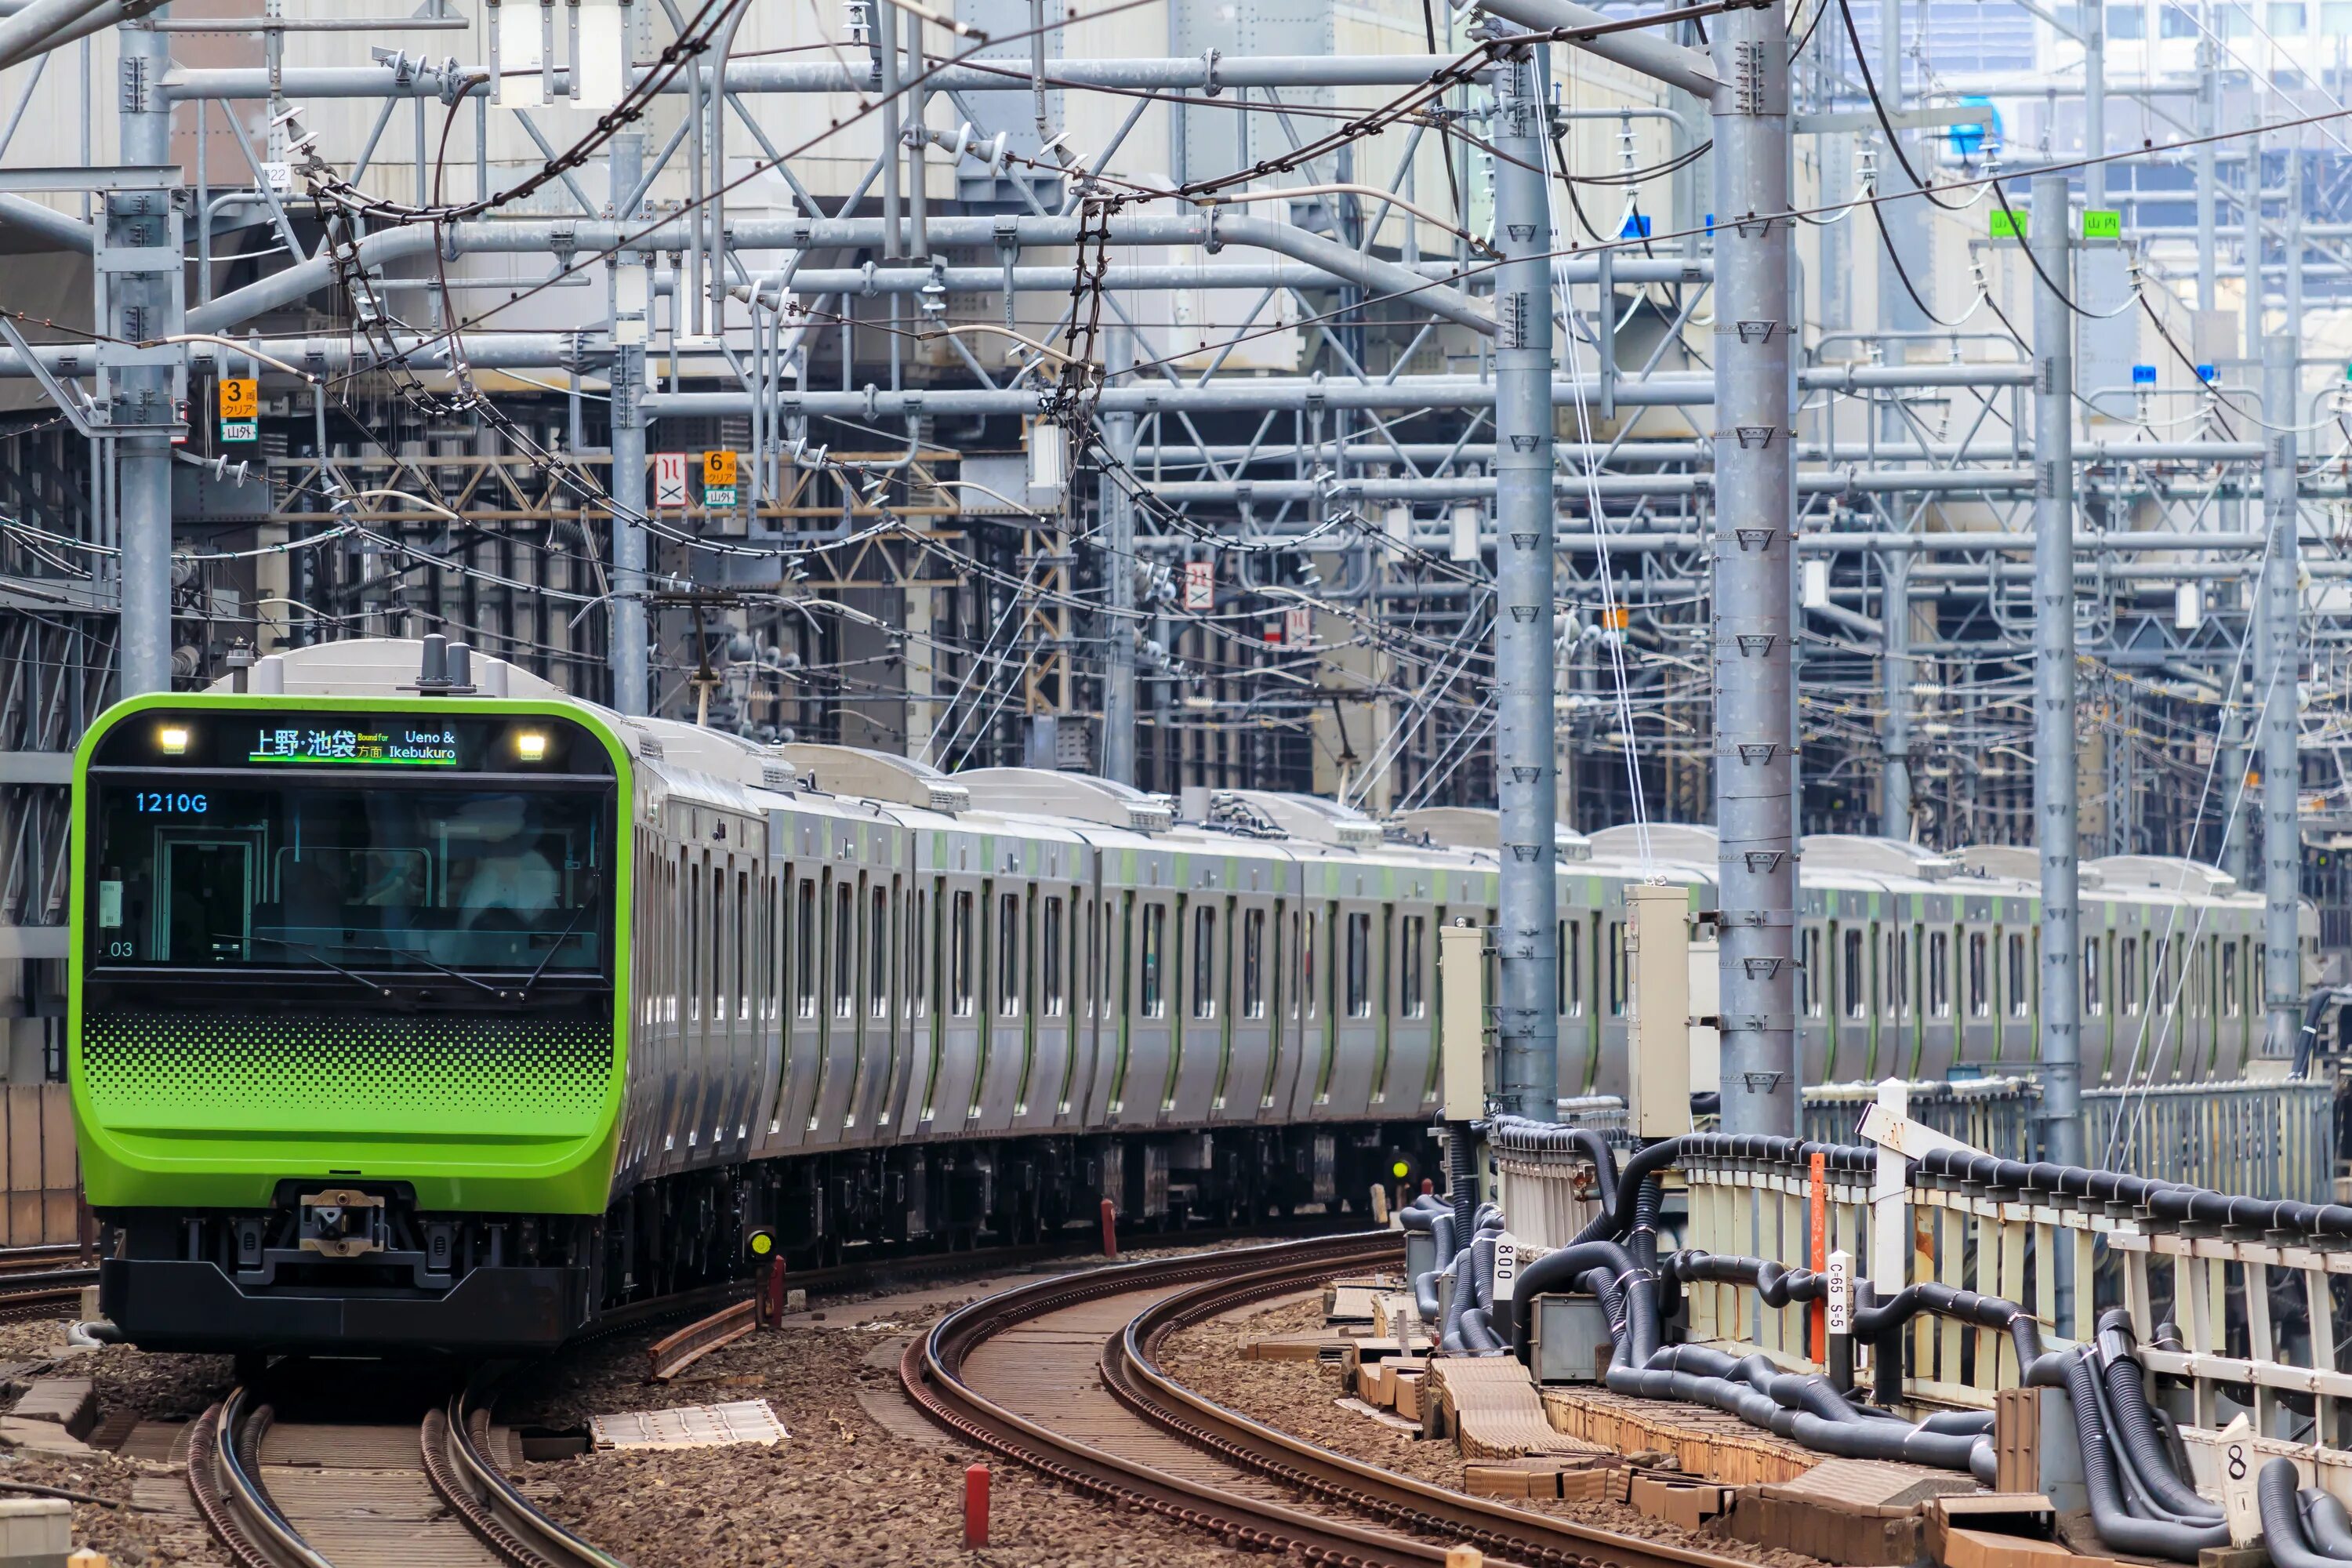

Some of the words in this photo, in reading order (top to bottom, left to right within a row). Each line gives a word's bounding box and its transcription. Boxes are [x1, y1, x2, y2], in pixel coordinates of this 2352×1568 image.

[2088, 216, 2116, 229] 山内
[225, 405, 252, 416] クリア
[227, 426, 251, 439] 山外
[709, 473, 732, 483] クリア
[710, 492, 731, 503] 山外
[358, 733, 377, 742] Bound
[378, 733, 389, 742] for
[405, 731, 440, 743] Ueno
[443, 731, 455, 743] &
[357, 746, 383, 758] 方面
[390, 746, 456, 758] Ikebukuro
[136, 793, 207, 812] 1210G
[111, 942, 132, 956] 03
[1497, 1245, 1513, 1279] 800
[1830, 1264, 1843, 1293] C=65
[1831, 1305, 1844, 1327] S=5
[2228, 1445, 2246, 1480] 8
